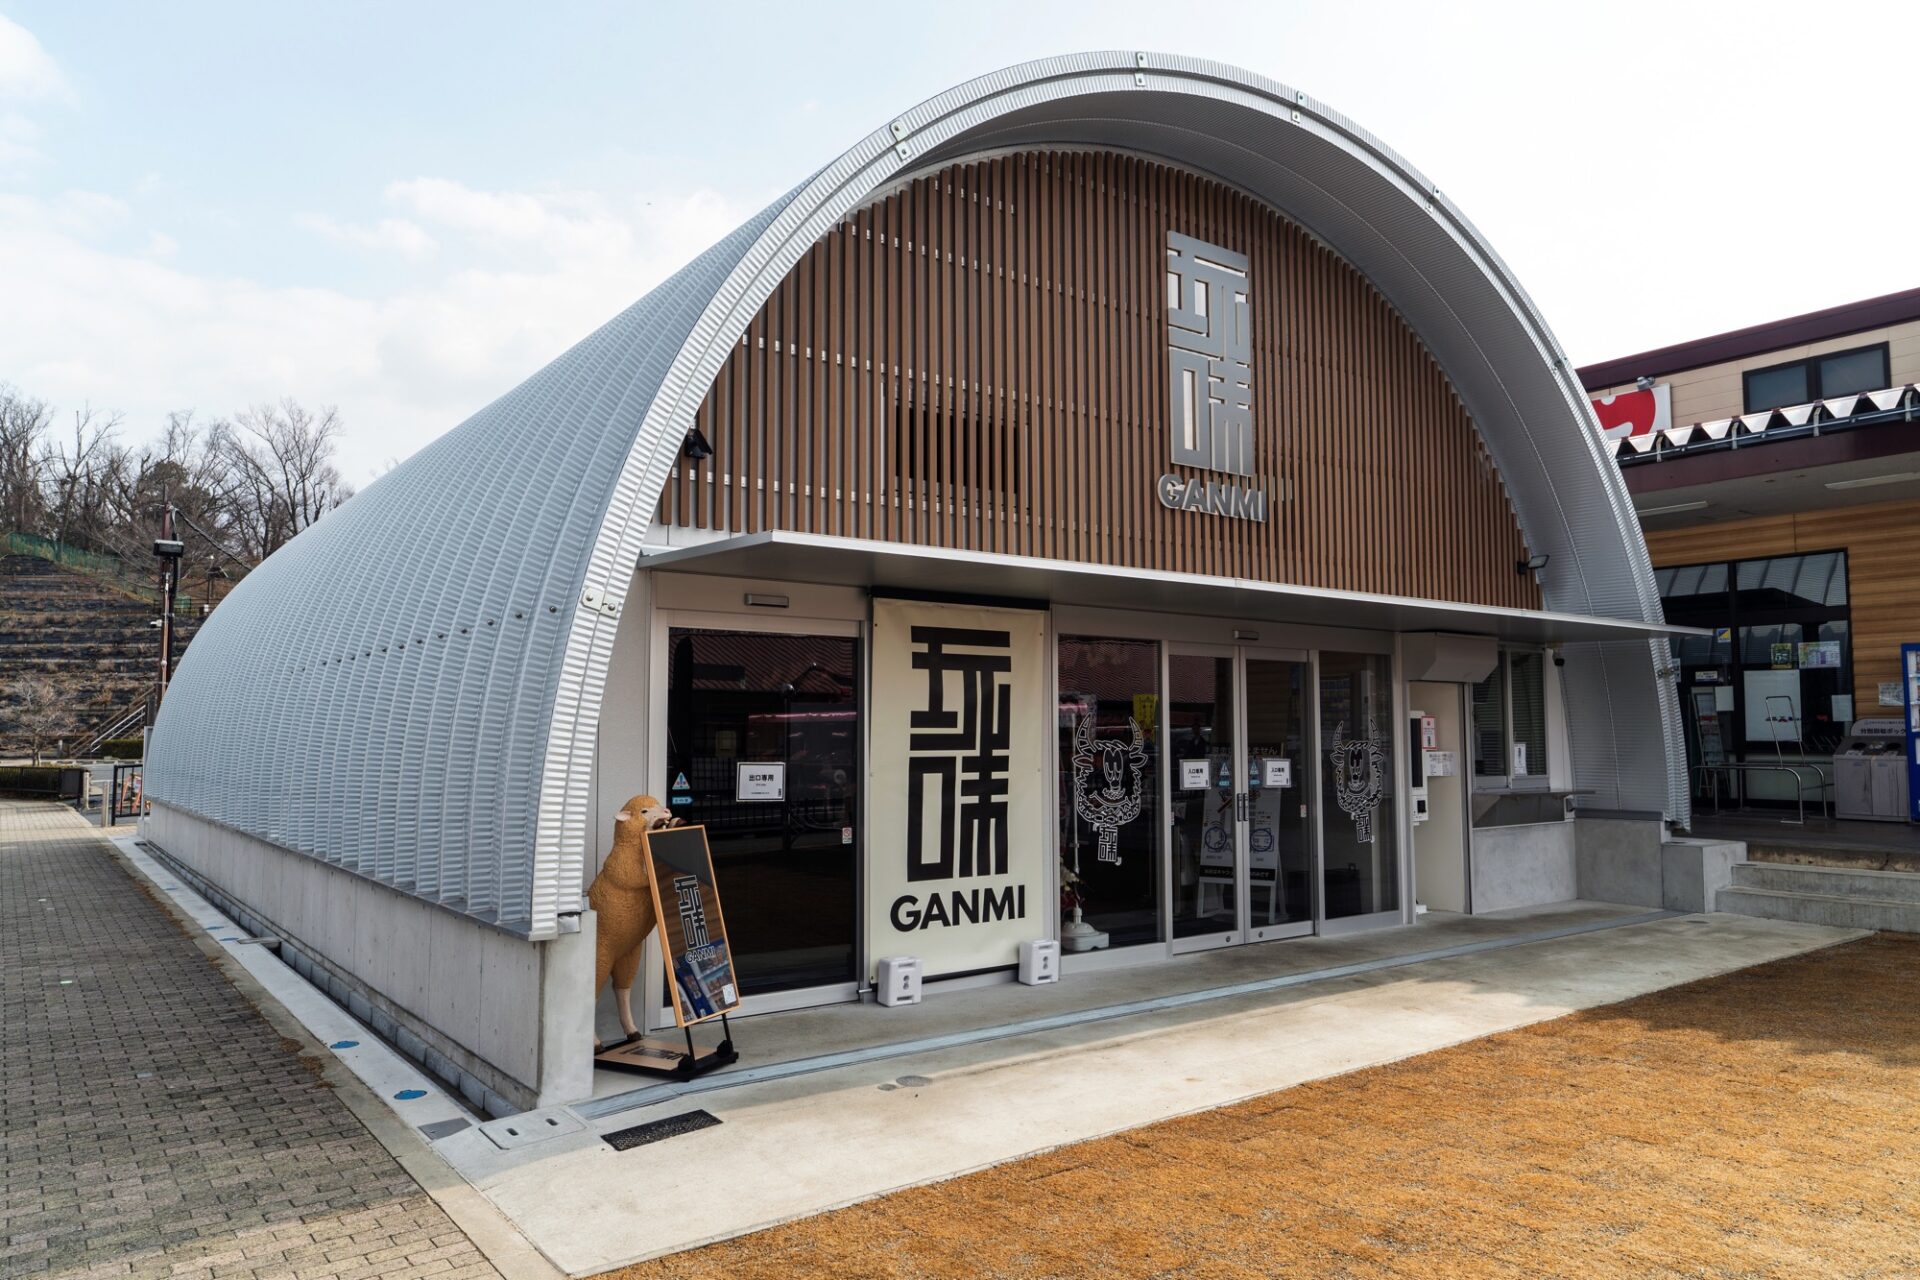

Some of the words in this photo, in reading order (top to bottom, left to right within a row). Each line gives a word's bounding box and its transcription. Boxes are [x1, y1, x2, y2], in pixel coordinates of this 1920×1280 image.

[1157, 473, 1268, 523] GANMI
[748, 774, 774, 782] 出口専用
[890, 884, 1025, 932] GANMI
[685, 945, 717, 964] GANMI
